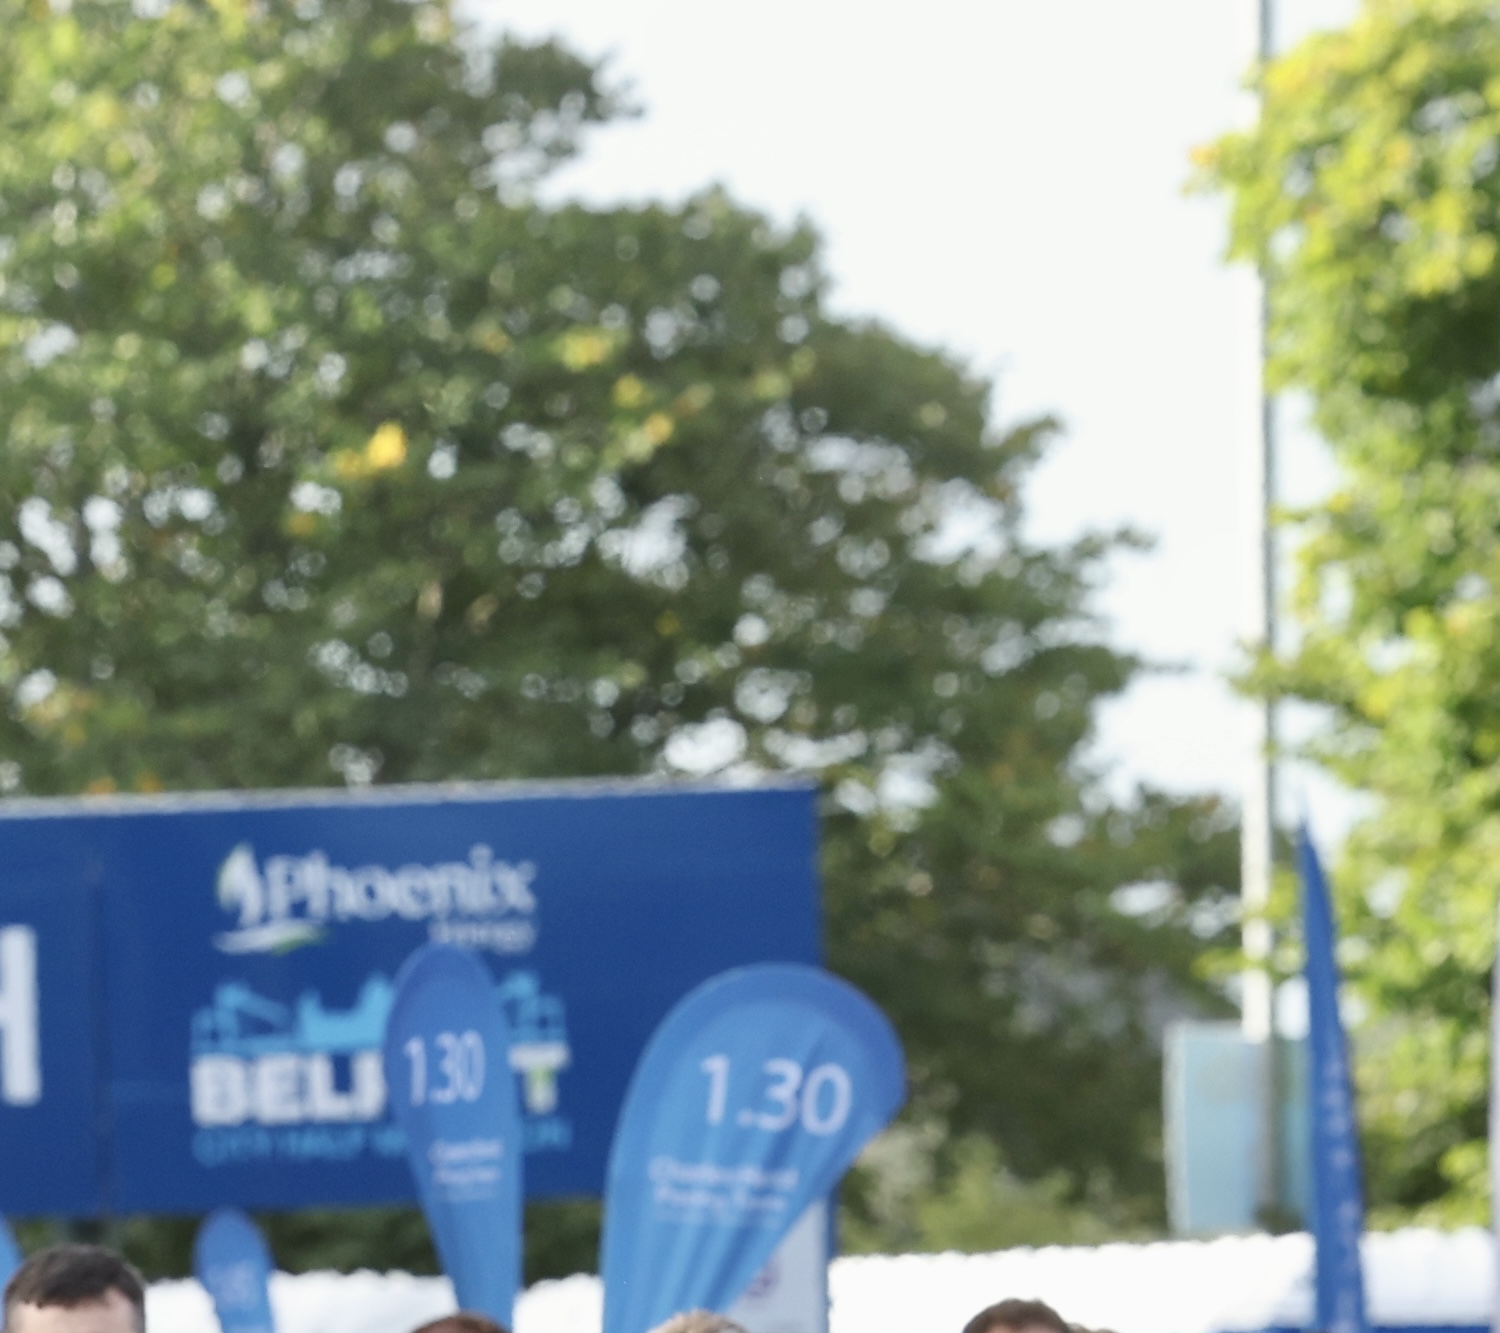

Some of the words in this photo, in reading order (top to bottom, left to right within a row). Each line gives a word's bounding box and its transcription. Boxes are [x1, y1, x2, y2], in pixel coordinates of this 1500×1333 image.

[264, 843, 537, 923] Phoenix
[190, 1042, 572, 1128] BELT
[404, 1028, 487, 1107] 1.30
[700, 1052, 853, 1137] 1.30
